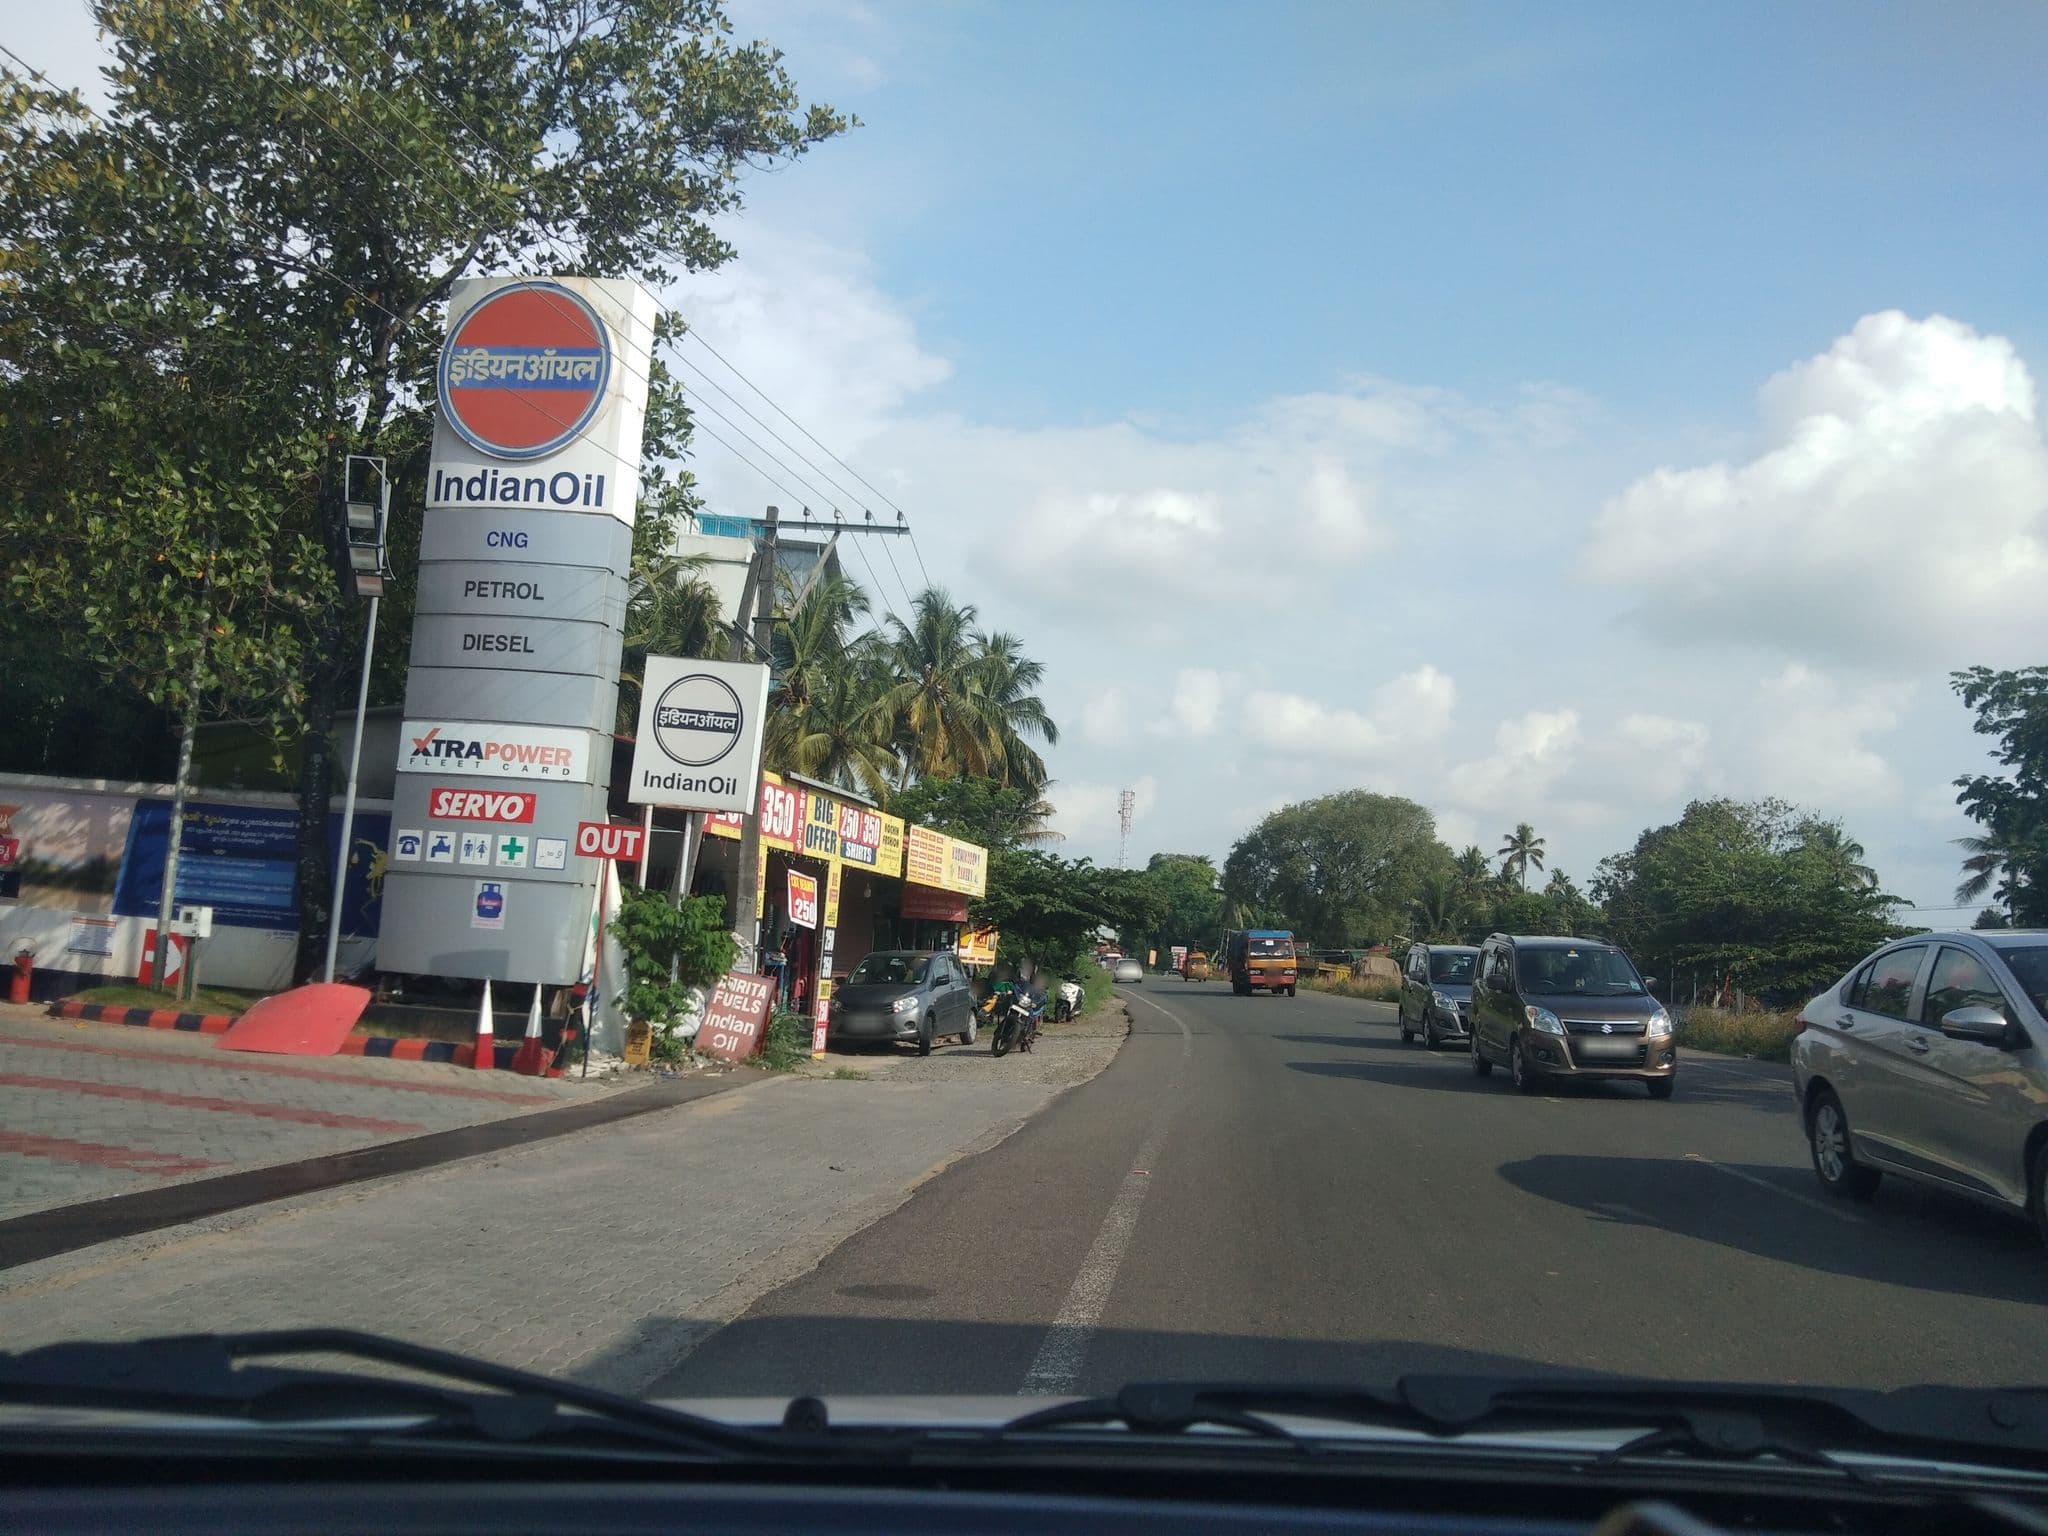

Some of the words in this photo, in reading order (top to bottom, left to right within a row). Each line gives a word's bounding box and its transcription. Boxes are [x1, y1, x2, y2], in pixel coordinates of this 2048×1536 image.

[449, 347, 600, 386] इंडियनऑयल
[433, 469, 606, 507] IndianOil
[486, 531, 528, 549] CNG
[464, 581, 545, 601] PETROL
[462, 633, 535, 653] DIESEL
[658, 708, 737, 730] इंडियनऑयल
[411, 727, 572, 766] XTRAPOWER
[409, 757, 481, 769] FLEET
[502, 763, 570, 776] CARD
[643, 770, 737, 796] IndianOil
[433, 791, 525, 821] SERVO
[761, 785, 795, 838] 350
[814, 795, 834, 825] BIG
[805, 822, 838, 855] OFFER
[840, 806, 859, 840] 250
[862, 814, 880, 847] 350
[579, 826, 642, 857] OUT
[845, 841, 873, 863] SHIRTS
[712, 990, 762, 1014] FUELS
[712, 1033, 739, 1052] Oil
